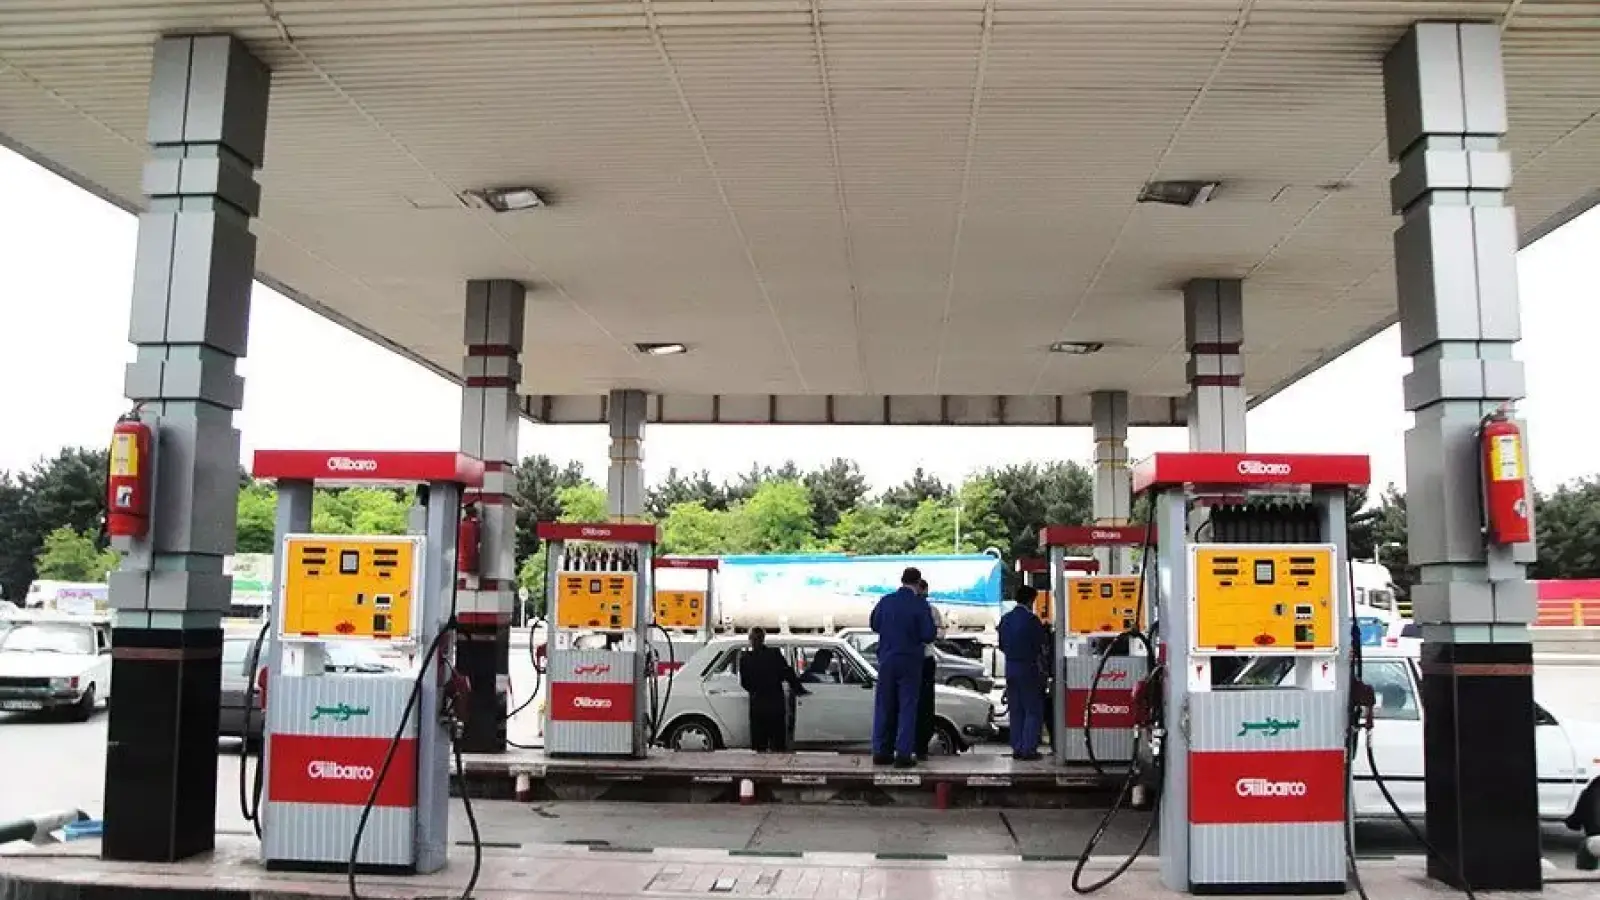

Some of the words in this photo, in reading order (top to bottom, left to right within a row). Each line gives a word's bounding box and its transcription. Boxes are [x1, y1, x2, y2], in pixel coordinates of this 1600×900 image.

[326, 456, 378, 471] Gilbarco
[1237, 460, 1292, 475] Gilbarco
[307, 760, 374, 780] Gilbarco
[1235, 777, 1306, 797] Gilbarco
